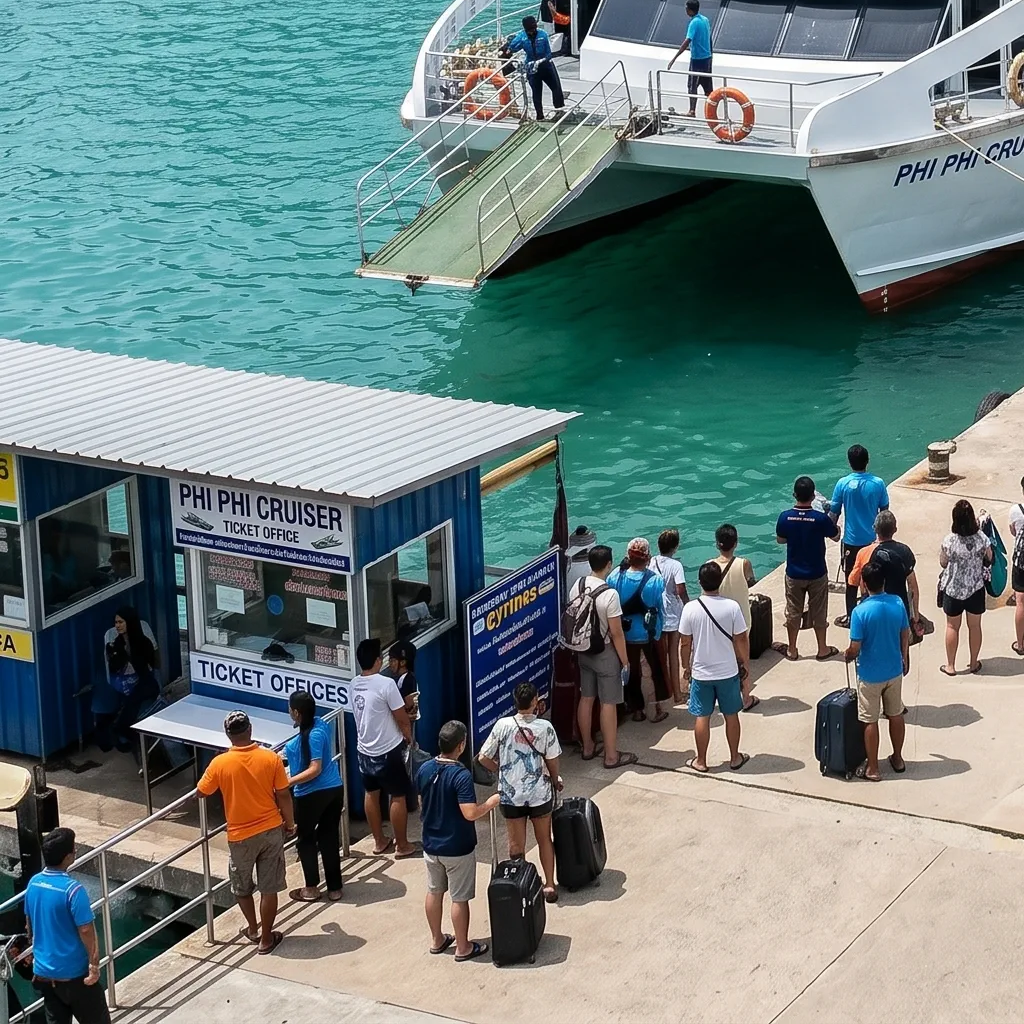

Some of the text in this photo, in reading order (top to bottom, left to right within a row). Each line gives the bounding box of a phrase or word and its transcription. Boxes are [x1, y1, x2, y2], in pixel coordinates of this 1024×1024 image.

[893, 158, 939, 188] PHI
[940, 147, 982, 177] PHI
[179, 482, 343, 533] PHI PHI CRUISER
[223, 520, 300, 544] TICKET OFFICE
[198, 659, 349, 705] TICKET OFFICES
